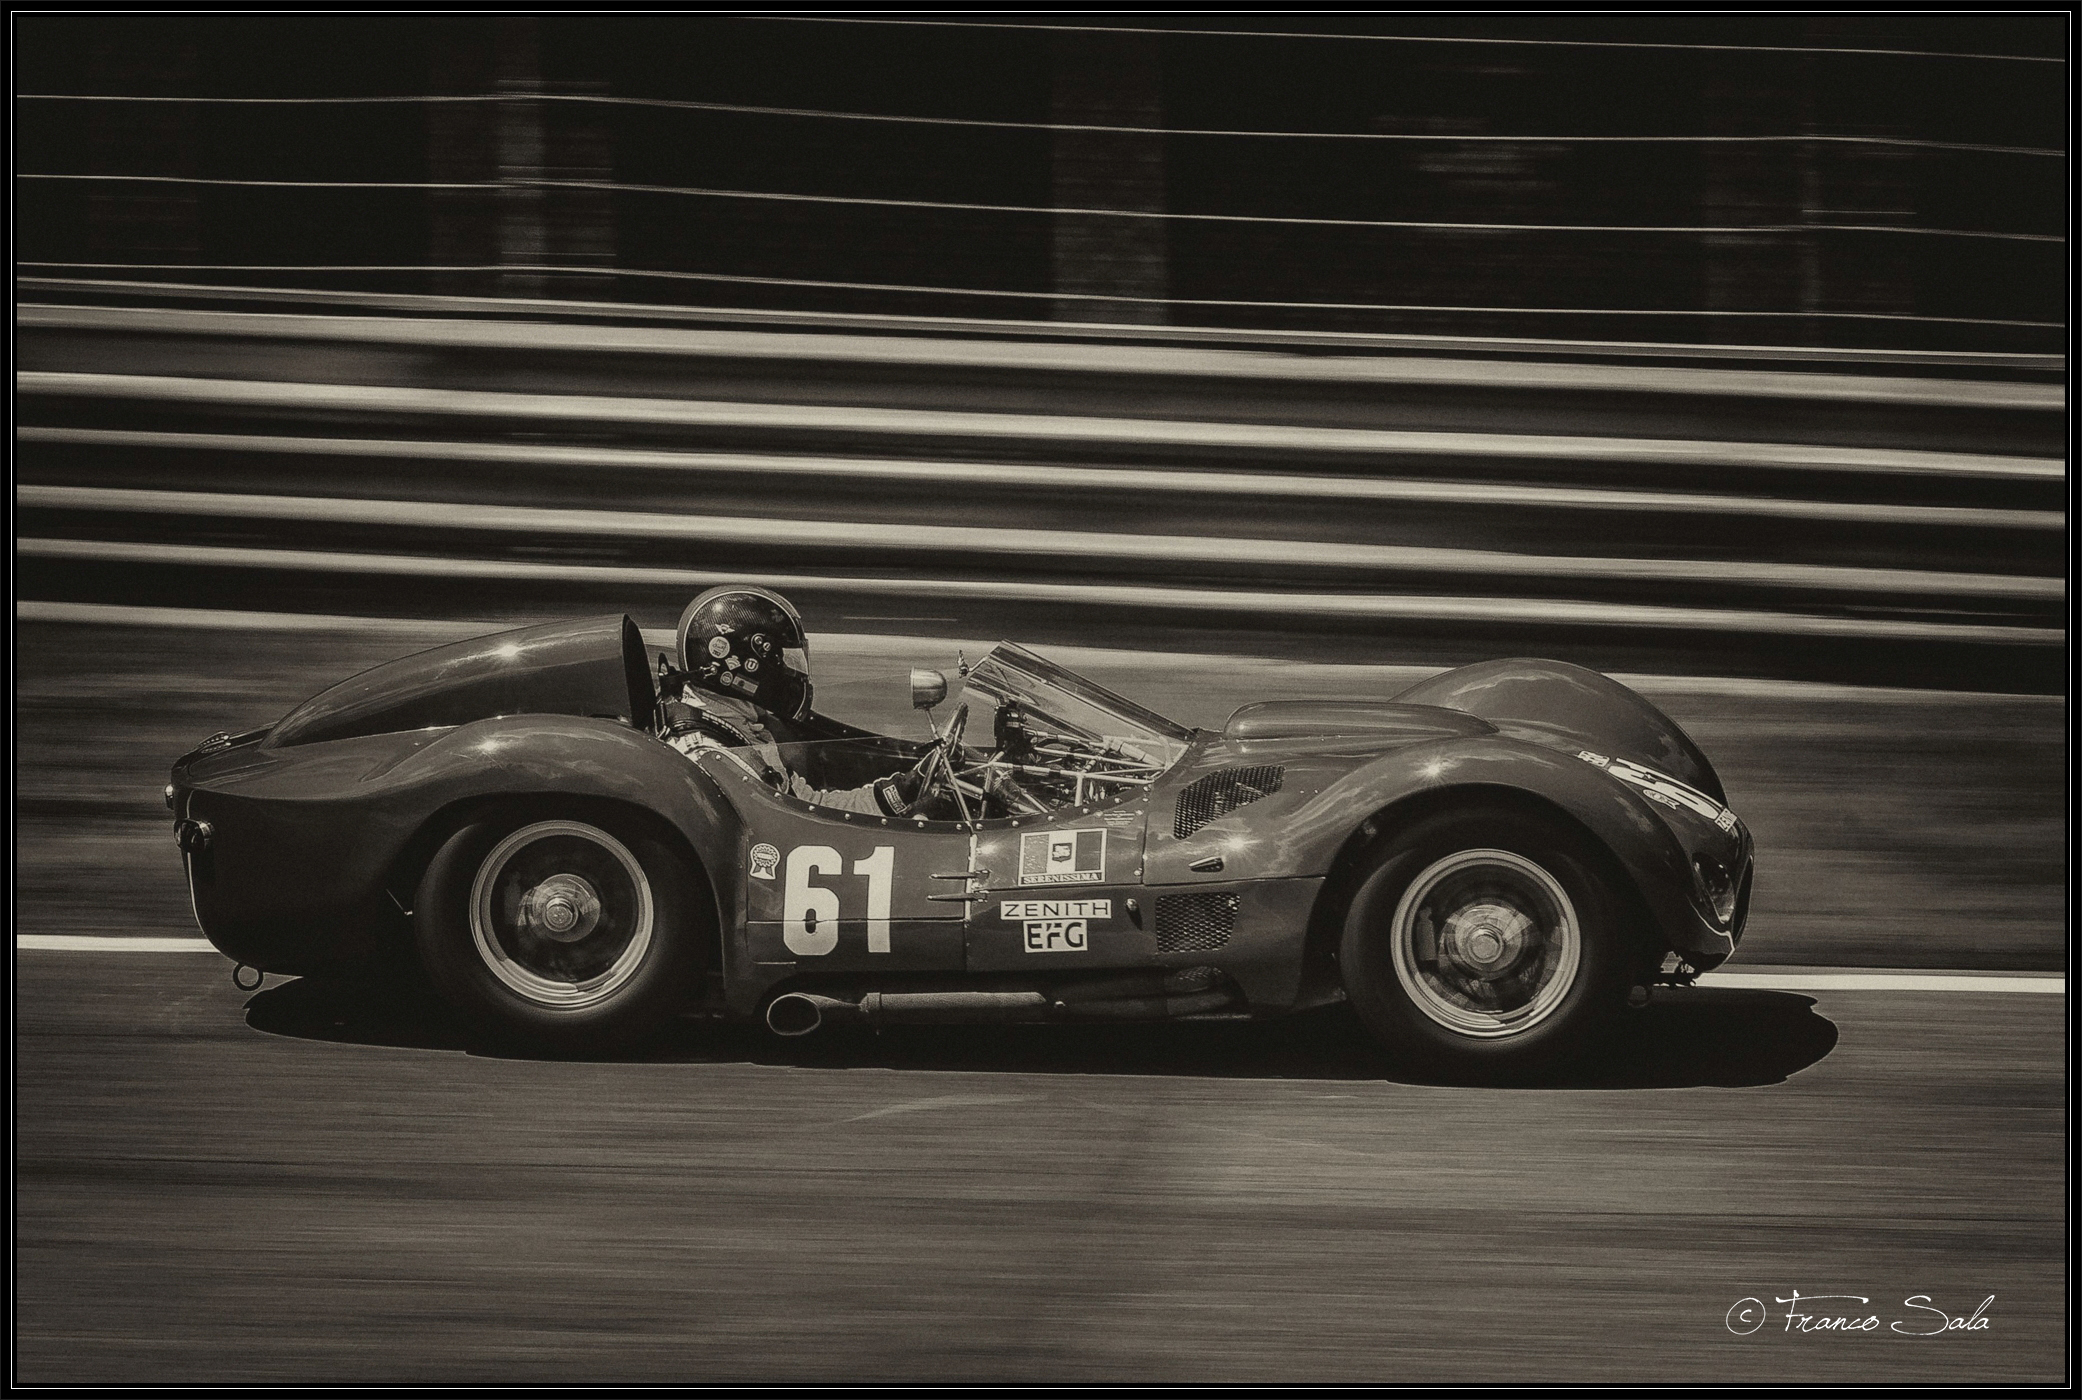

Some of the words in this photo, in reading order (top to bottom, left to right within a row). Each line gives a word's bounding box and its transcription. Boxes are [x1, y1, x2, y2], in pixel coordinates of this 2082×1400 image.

[1023, 872, 1100, 884] SERENISSIMA
[783, 845, 895, 956] 61
[1004, 902, 1108, 917] ZENITH
[1026, 921, 1084, 949] EFG
